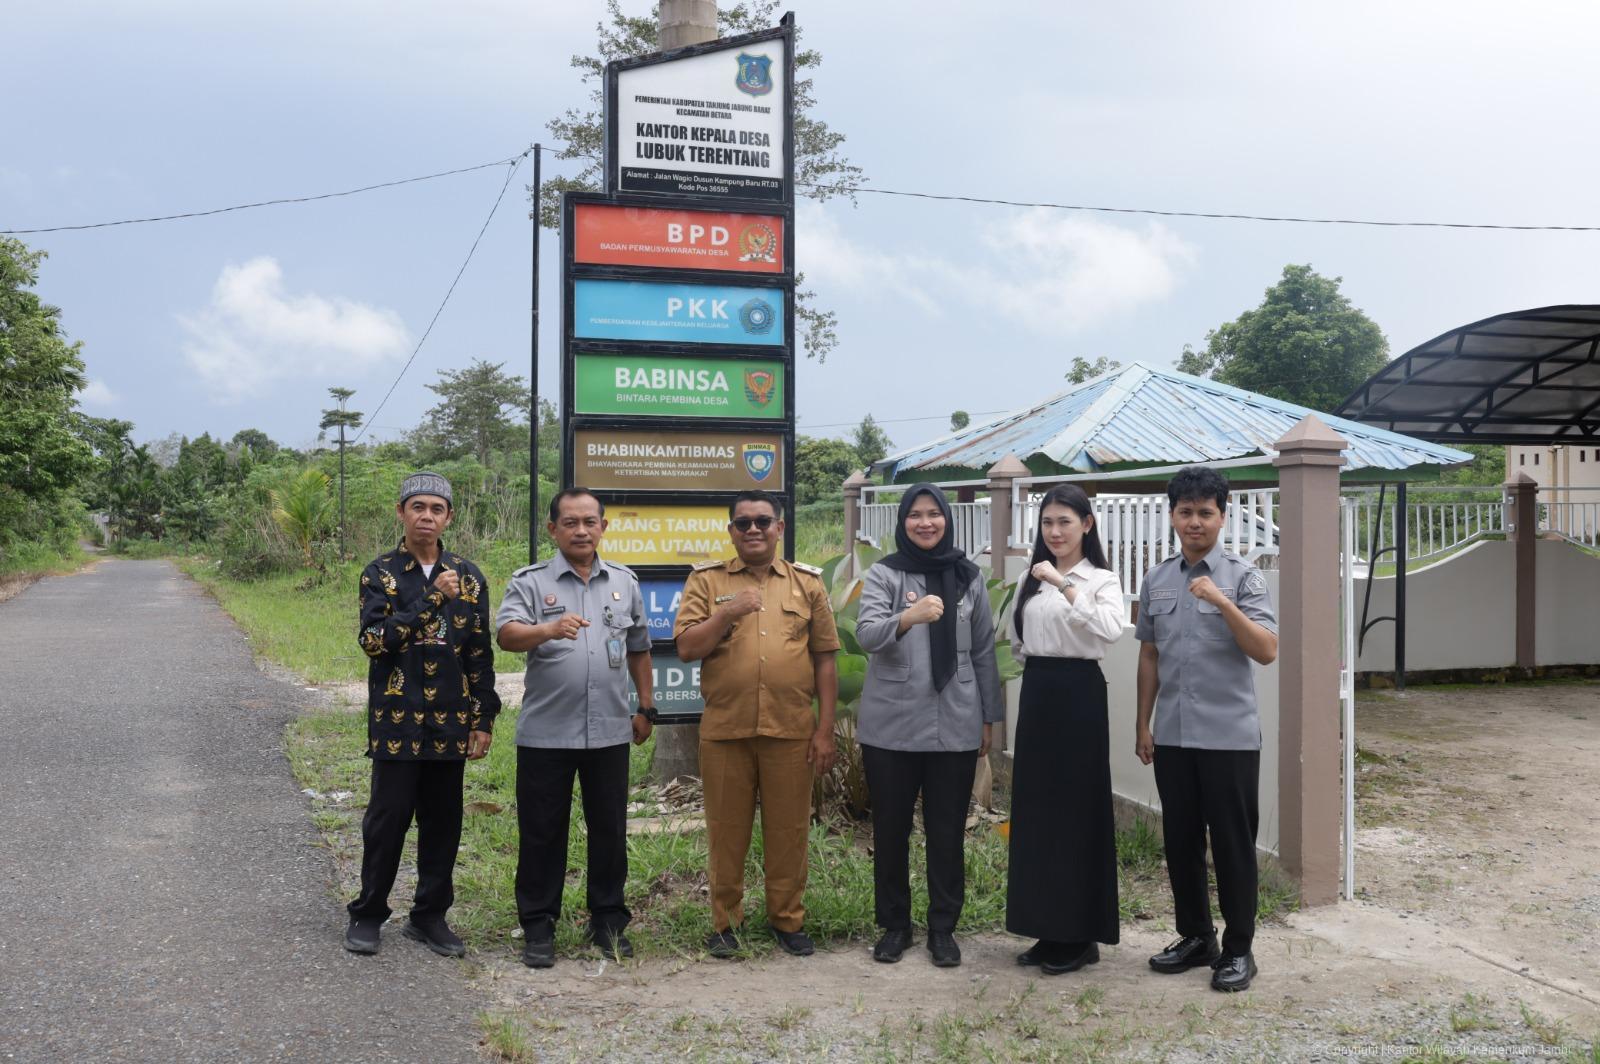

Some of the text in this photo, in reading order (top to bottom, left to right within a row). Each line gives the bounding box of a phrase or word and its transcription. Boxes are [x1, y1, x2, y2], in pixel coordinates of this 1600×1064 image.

[635, 96, 671, 105] PEMERINTAH
[672, 98, 704, 108] KABUPATEN
[706, 101, 730, 110] TANJUNG
[731, 104, 752, 112] JABUNG
[676, 108, 732, 119] KECAMATAN BETARA
[636, 122, 770, 147] KANTOR KEPALA DESA
[636, 142, 770, 168] LUBUK TERENTANG
[626, 170, 649, 179] Alamat
[673, 174, 692, 183] Wagio
[715, 177, 744, 187] Kampung
[668, 224, 730, 246] BPD
[600, 243, 729, 257] BADAN PERMUSYAWARATAN DESA
[668, 298, 729, 320] PKK
[615, 367, 729, 392] BABINSA
[616, 394, 728, 405] BINTARA PEMBINA DESA
[587, 444, 735, 458] BHABINKAMTIBMAS
[588, 460, 642, 468] BHAYANGKARA
